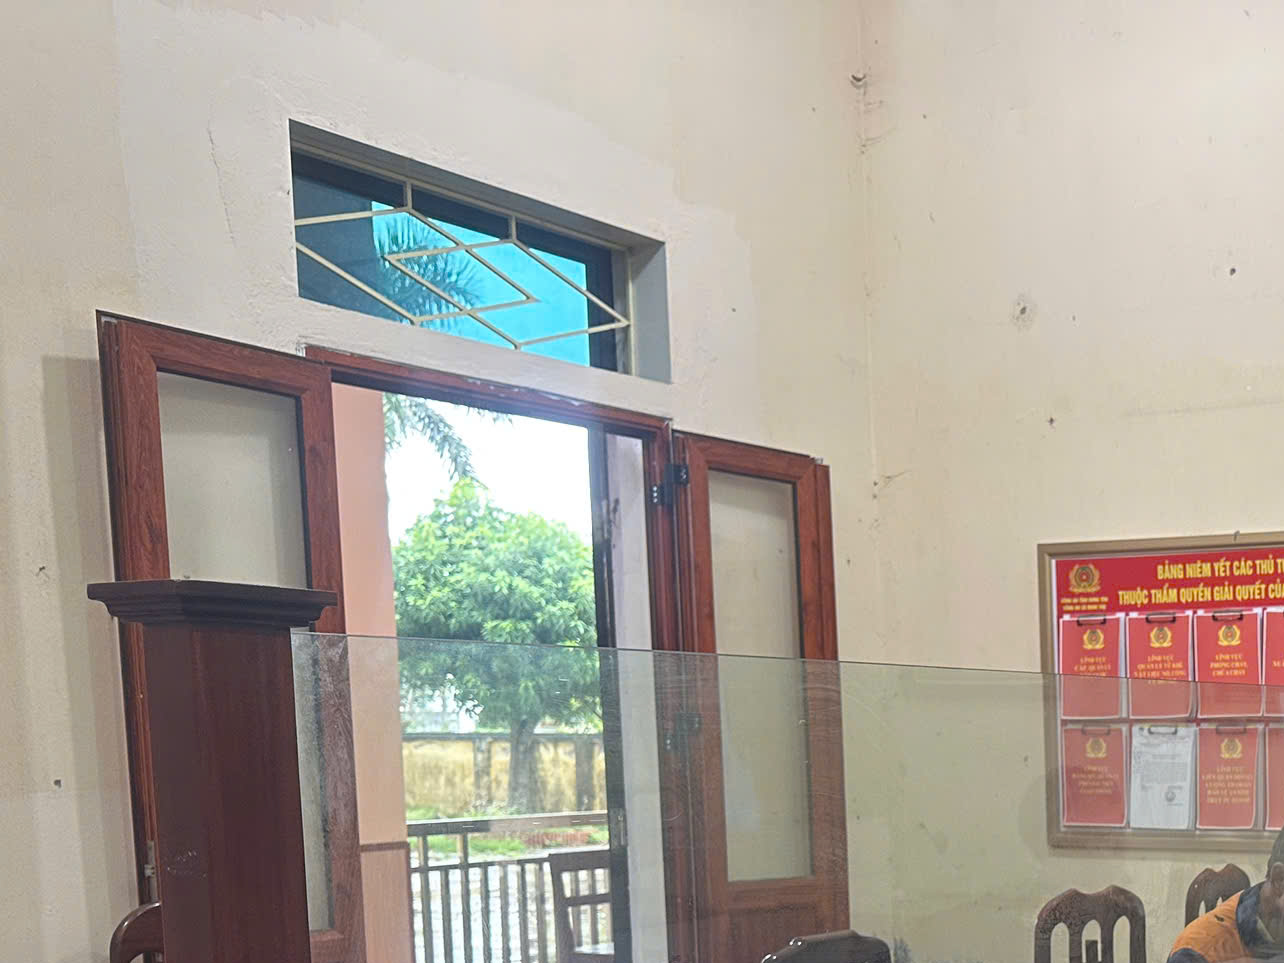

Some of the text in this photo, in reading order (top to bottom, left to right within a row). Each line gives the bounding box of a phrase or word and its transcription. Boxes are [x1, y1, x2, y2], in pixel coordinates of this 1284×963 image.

[1157, 560, 1184, 580] BẢNG
[1186, 560, 1211, 578] NIÊM
[1213, 558, 1230, 576] YẾT
[1233, 558, 1252, 576] CÁC
[1256, 554, 1274, 574] THỦ
[1118, 587, 1148, 608] THUỘC
[1151, 583, 1178, 604] THẨM
[1180, 583, 1211, 604] QUYỀN
[1214, 582, 1233, 600] GIẢI
[1236, 580, 1266, 601] QUYẾT
